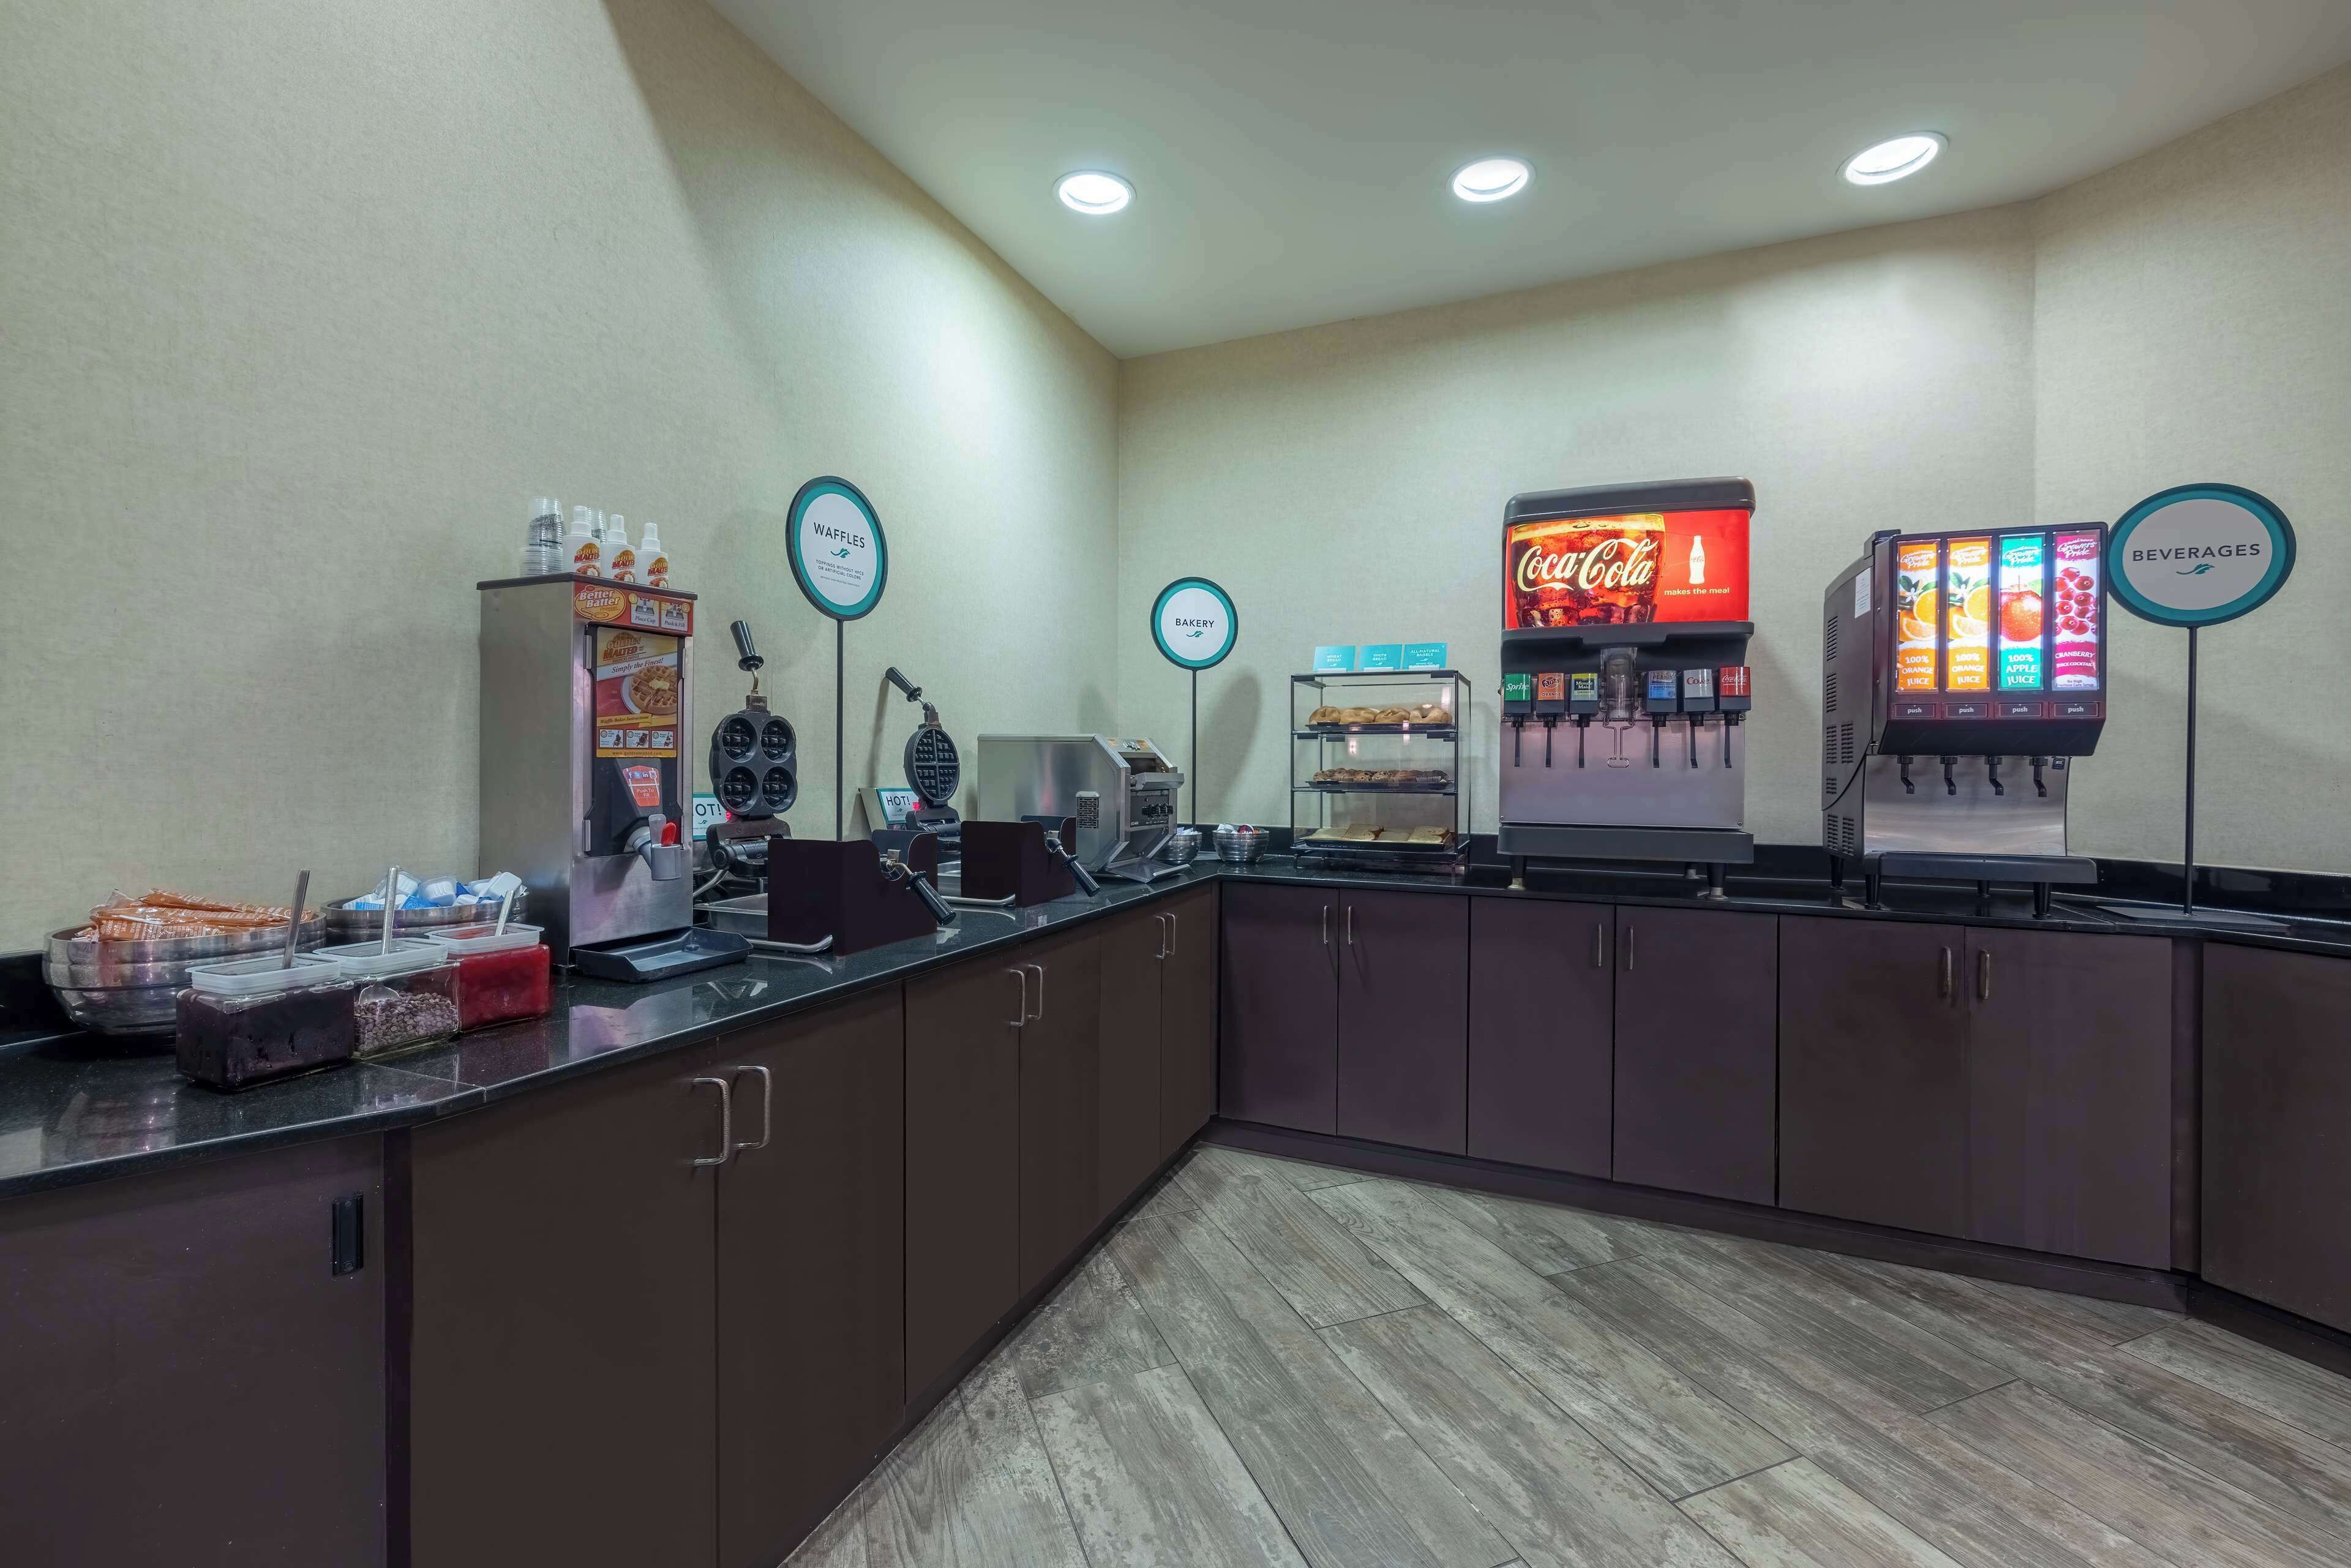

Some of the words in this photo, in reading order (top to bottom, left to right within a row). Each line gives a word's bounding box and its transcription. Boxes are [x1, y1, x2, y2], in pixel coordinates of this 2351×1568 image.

[814, 522, 865, 548] WAFFLES
[2057, 542, 2098, 552] Growers
[2065, 550, 2091, 558] Pride
[2132, 544, 2260, 561] BEVERAGES
[816, 559, 836, 569] TOPPINGS
[1518, 538, 1659, 591] Coca-Cola
[825, 568, 846, 576] ARTIFICIAL
[579, 590, 614, 601] Better
[586, 597, 620, 608] Batter
[1176, 618, 1215, 628] BAKERY
[603, 646, 637, 659] MALTED
[1955, 653, 1980, 662] 100%
[1905, 655, 1930, 664] 100%
[2008, 654, 2034, 662] 100%
[612, 663, 633, 673] Simply
[645, 657, 664, 666] Finest!
[2006, 664, 2038, 673] APPLE
[1686, 677, 1709, 685] Coke
[1957, 676, 1981, 685] JUICE
[2007, 675, 2036, 686] JUICE
[1506, 683, 1529, 692] Sprite
[886, 796, 910, 806] HOT!
[696, 803, 721, 816] OT!
